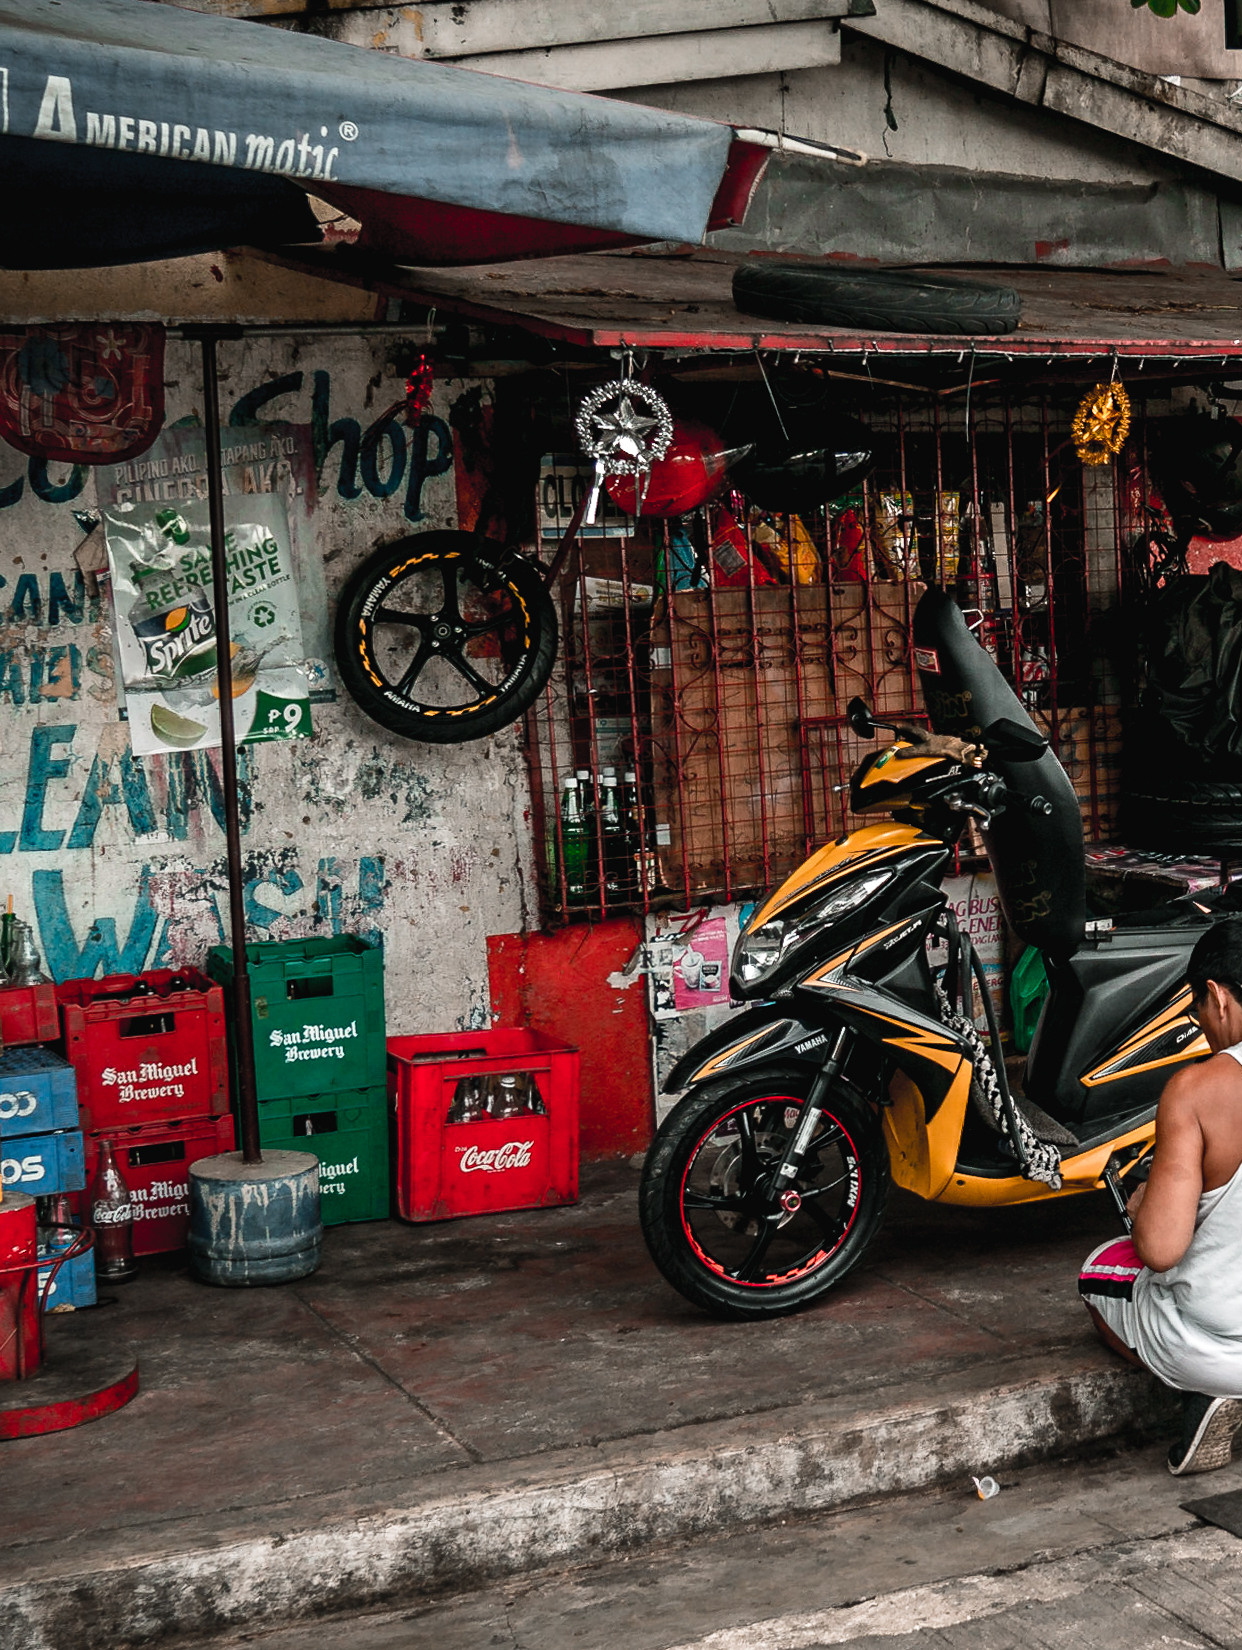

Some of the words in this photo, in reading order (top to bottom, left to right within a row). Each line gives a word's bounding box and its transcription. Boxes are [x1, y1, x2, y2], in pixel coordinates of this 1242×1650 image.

[33, 75, 238, 168] AMERICAN
[115, 457, 169, 486] PILIPINO
[179, 533, 238, 573] SAE
[145, 537, 279, 611] REFREHING
[226, 555, 281, 596] ASTE
[360, 577, 391, 617] YAMAHA
[150, 612, 214, 674] Sprite
[269, 1029, 301, 1047] San
[302, 1020, 358, 1043] Miguel
[794, 1034, 828, 1055] YAMAHA
[285, 1045, 345, 1064] Brewery
[101, 1067, 137, 1086] San
[139, 1057, 198, 1083] Miguel
[118, 1083, 184, 1103] Brewery
[319, 1155, 359, 1180] iguel
[460, 1140, 534, 1173] Coca-Cola
[130, 1187, 148, 1202] an
[149, 1180, 189, 1201] Mig
